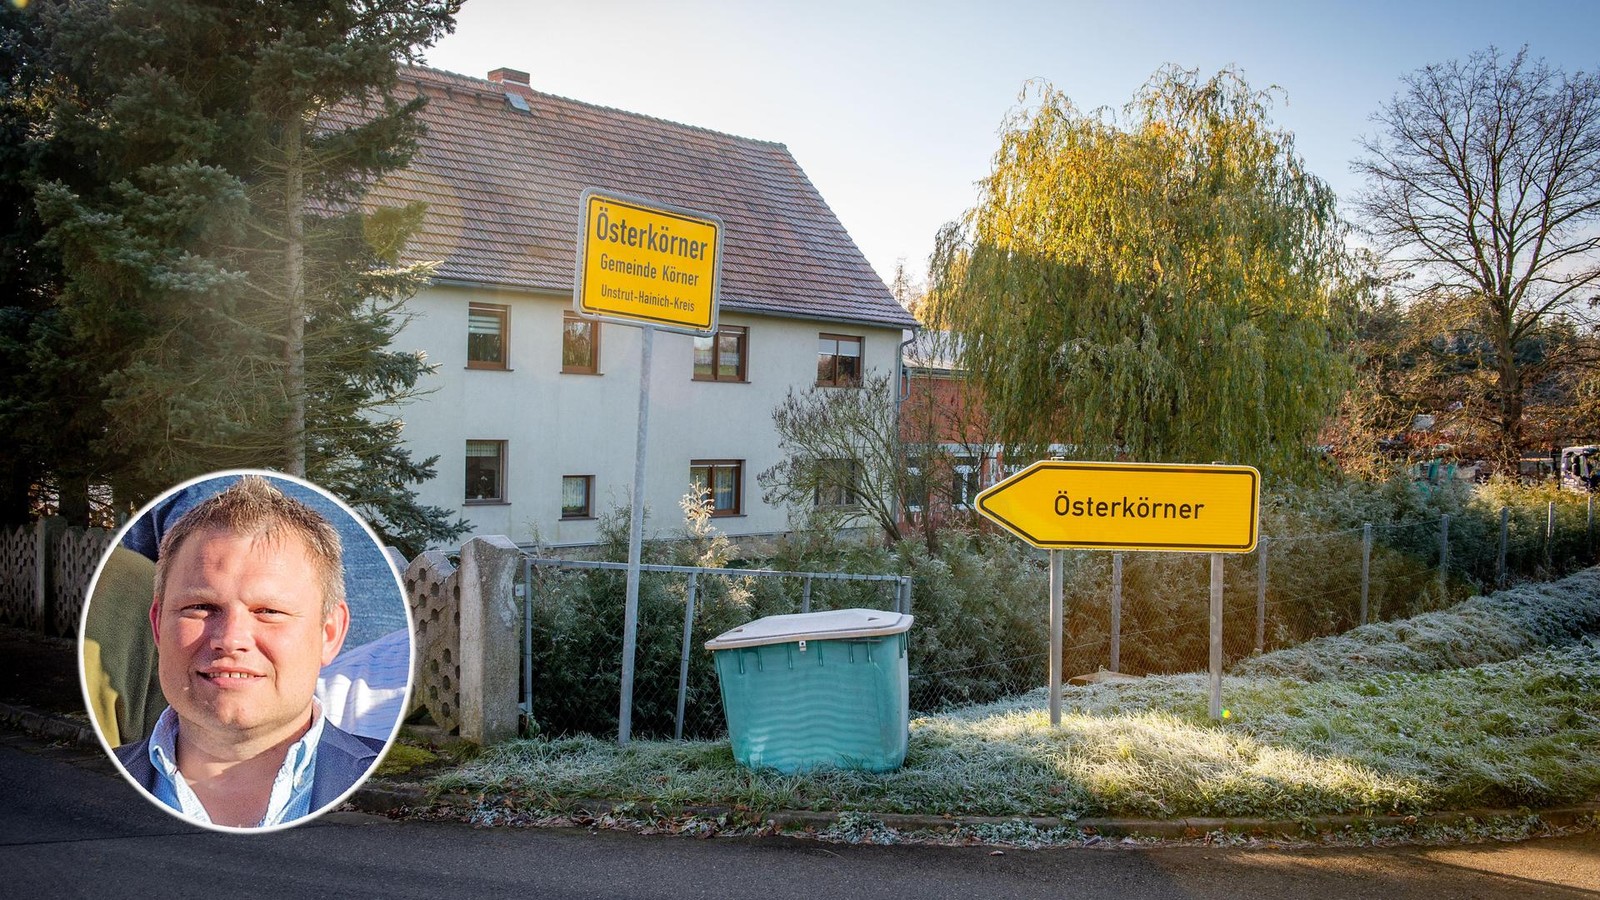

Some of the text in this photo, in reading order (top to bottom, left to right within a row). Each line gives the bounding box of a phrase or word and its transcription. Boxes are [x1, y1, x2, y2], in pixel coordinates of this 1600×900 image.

[596, 206, 708, 261] Österkörner
[600, 253, 699, 287] Gemeinde Körner
[601, 284, 695, 312] Unstrut-Hainich-Kreis
[1054, 490, 1205, 520] Österkörner
